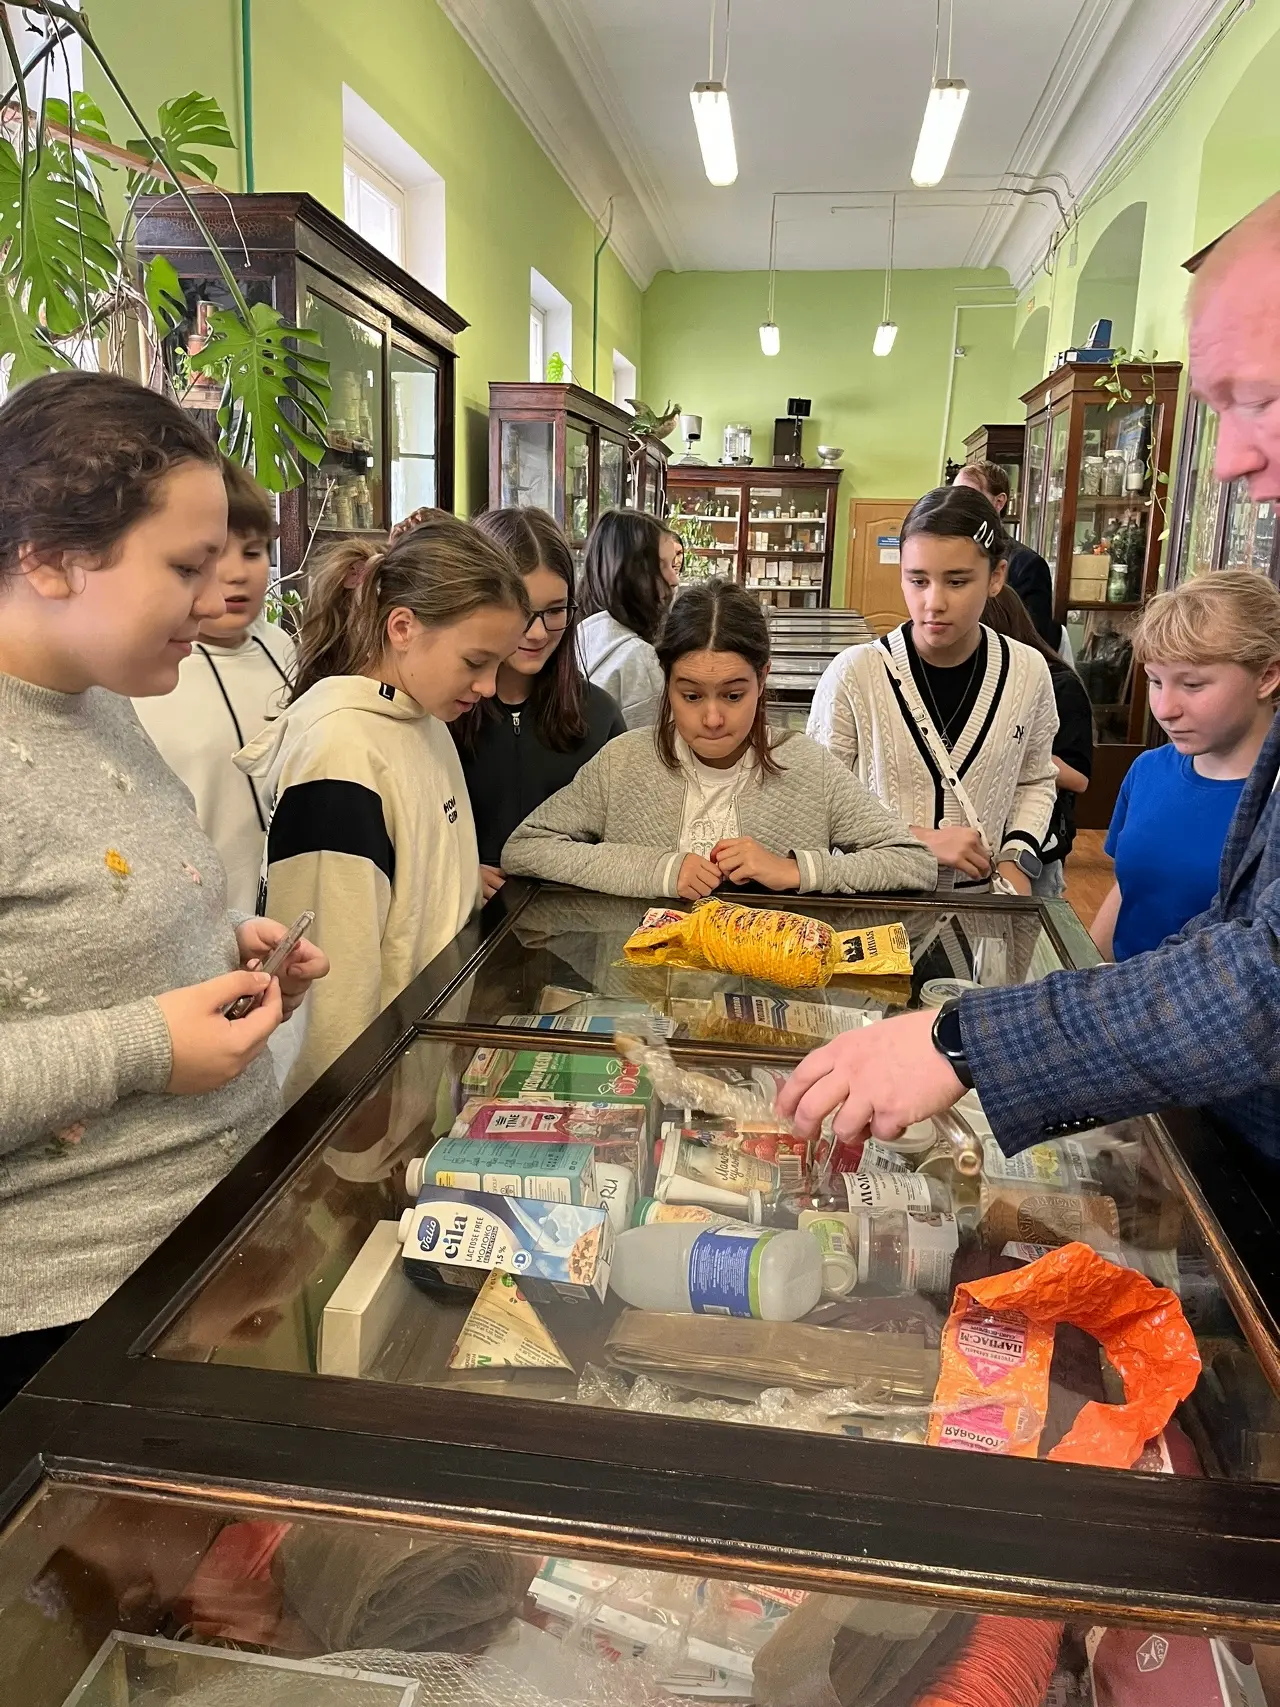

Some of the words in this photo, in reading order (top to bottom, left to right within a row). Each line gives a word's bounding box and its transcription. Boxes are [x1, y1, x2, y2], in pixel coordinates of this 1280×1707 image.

[506, 1114, 519, 1129] TINE
[420, 1219, 438, 1250] Valio
[443, 1214, 468, 1259] eila
[465, 1232, 480, 1262] LACTOSE
[474, 1216, 484, 1233] FREE
[476, 1224, 492, 1263] МОЛОКО
